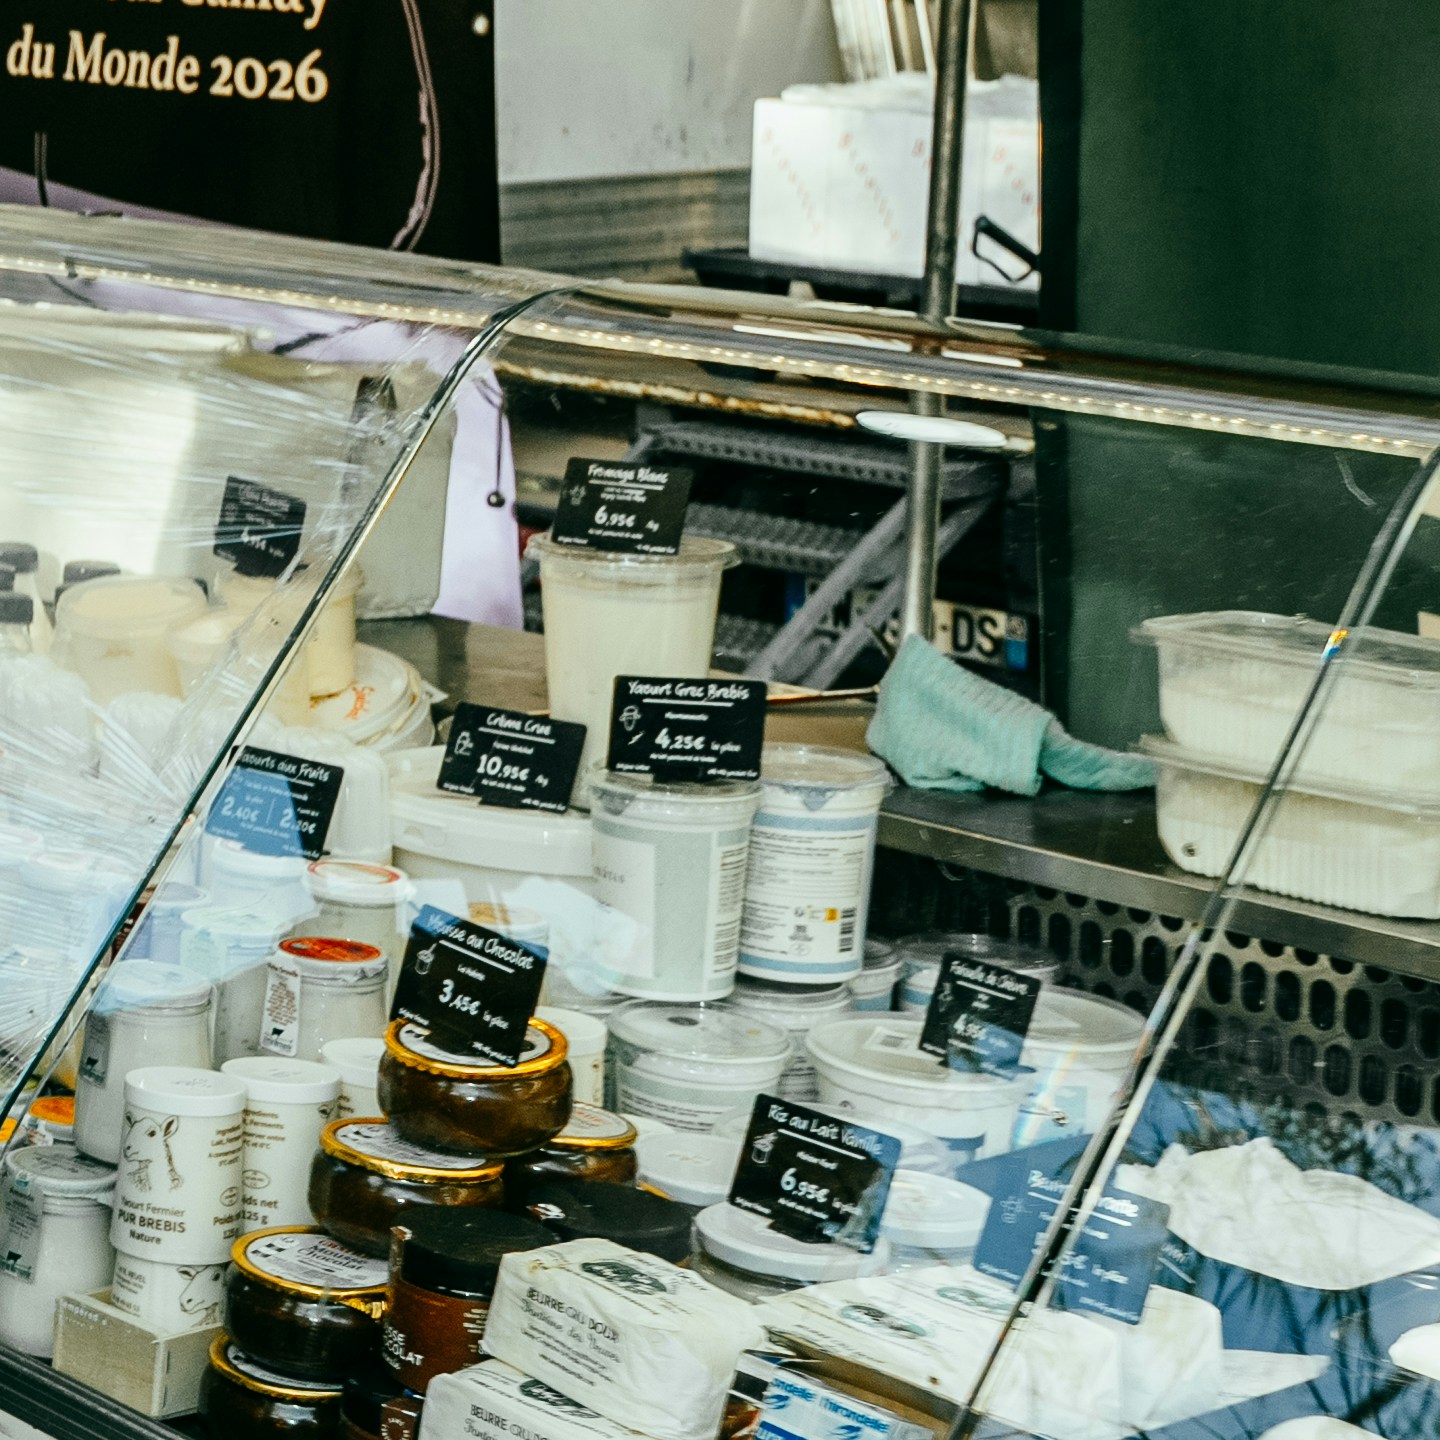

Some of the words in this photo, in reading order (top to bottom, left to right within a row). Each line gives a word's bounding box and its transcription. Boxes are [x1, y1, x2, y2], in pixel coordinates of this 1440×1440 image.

[6, 22, 55, 78] du
[62, 29, 201, 94] Monde
[209, 49, 329, 102] 2026
[628, 680, 672, 696] Yaourt
[674, 682, 705, 697] Grec
[707, 683, 750, 700] Brebis
[654, 727, 706, 750] 4,25€
[239, 752, 275, 769] aourts
[295, 762, 331, 782] Fruits
[476, 753, 530, 781] 10,95€
[466, 933, 485, 950] au
[484, 937, 535, 970] Chocolat
[767, 1103, 790, 1123] Riz
[789, 1115, 811, 1131] au
[810, 1118, 840, 1140] Lait
[118, 1209, 136, 1225] PUR
[138, 1215, 186, 1233] BREBIS
[146, 1202, 185, 1217] Fermier
[129, 1229, 161, 1245] Nature
[526, 1286, 565, 1314] BEURRE
[470, 1403, 508, 1431] BEURRE
